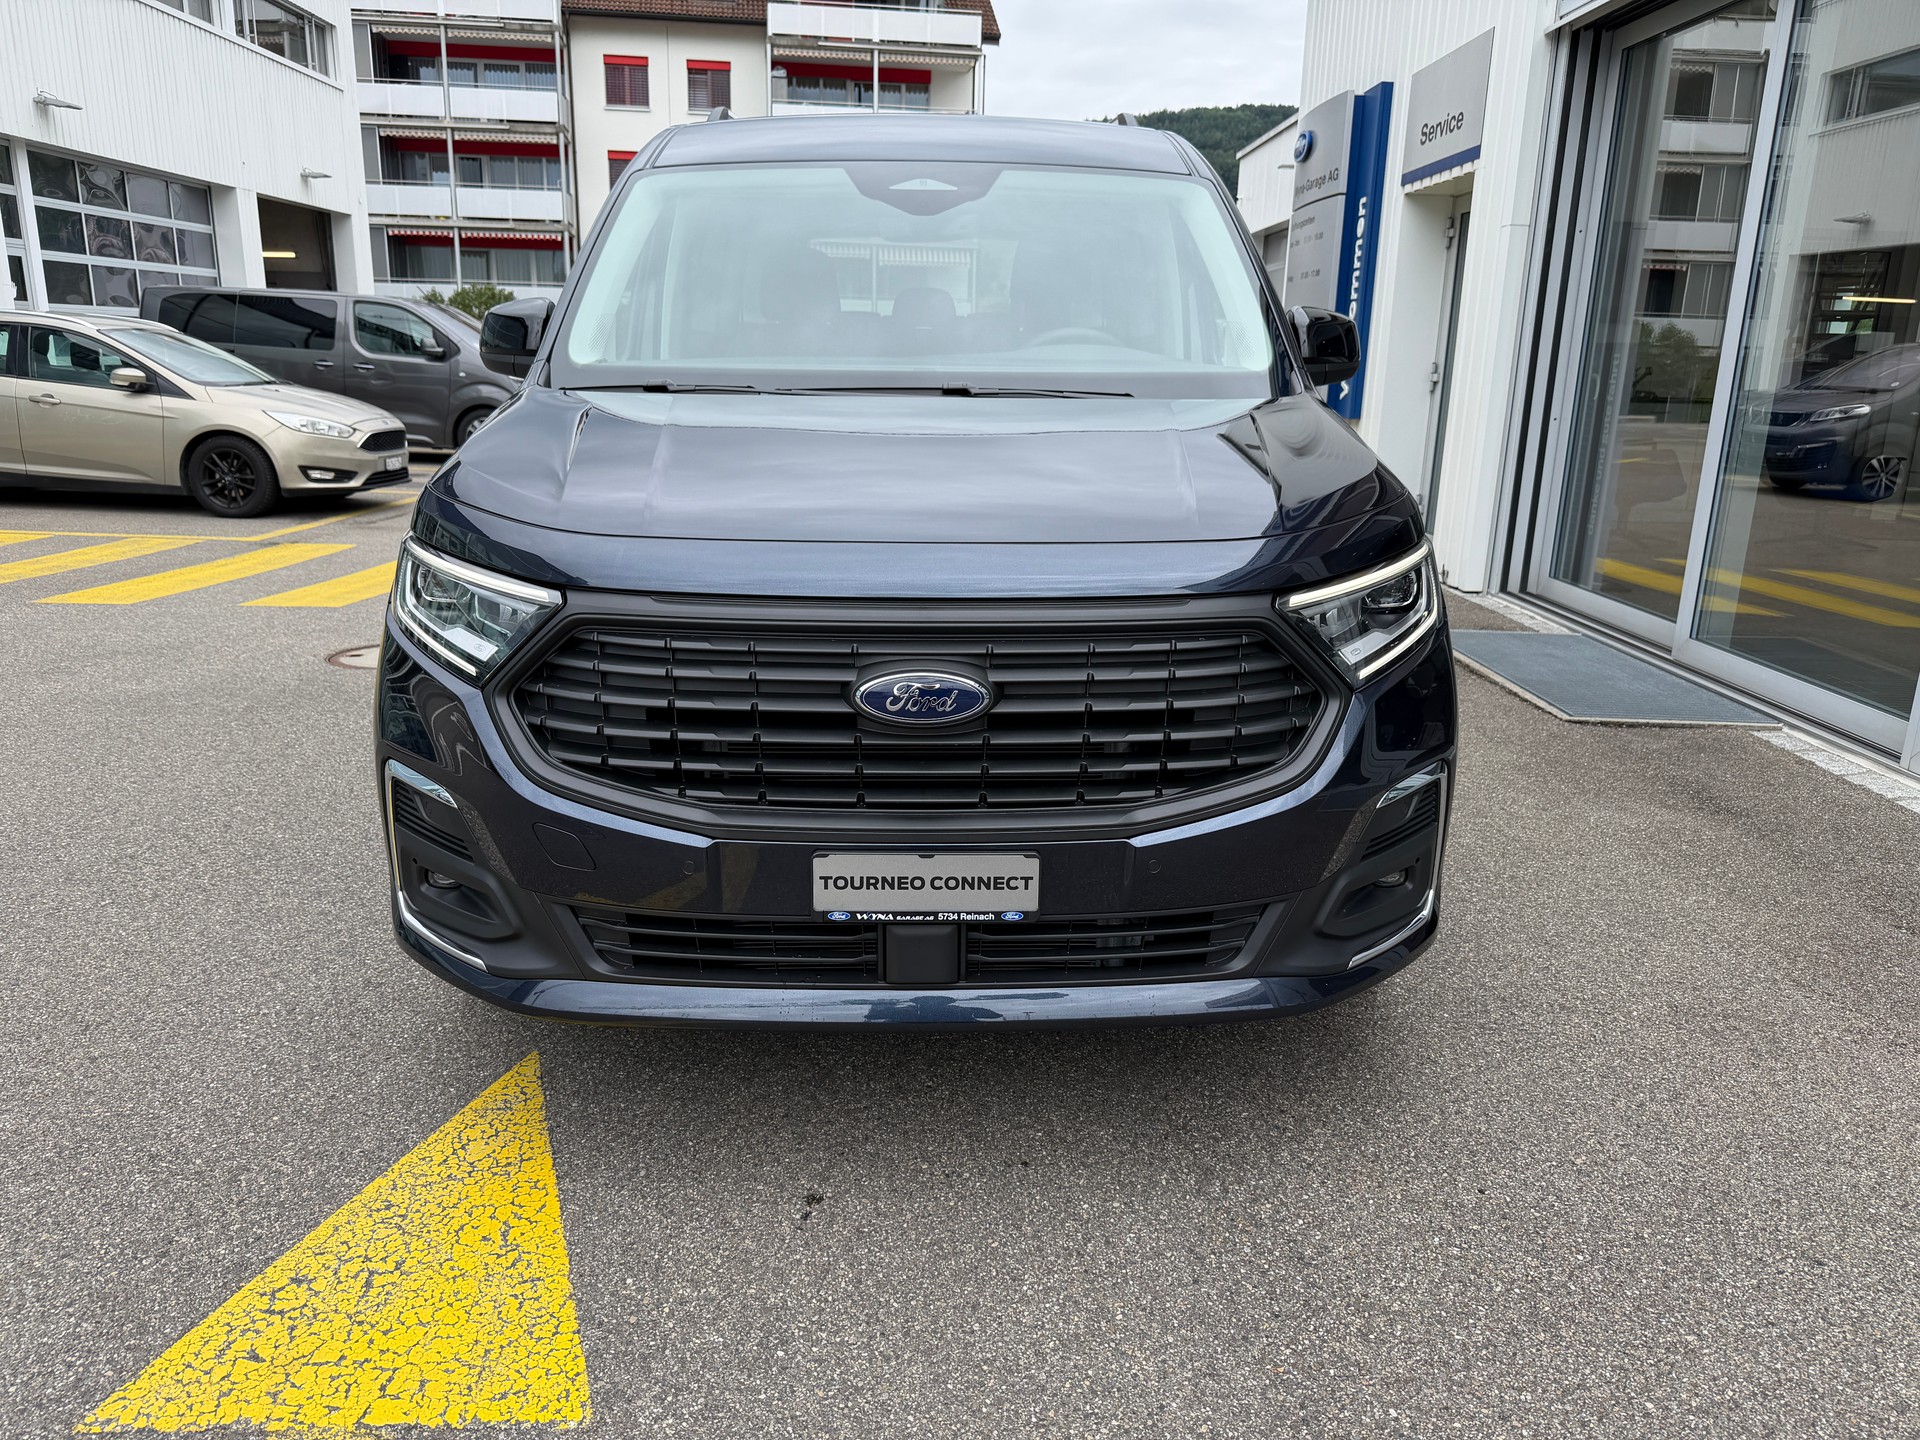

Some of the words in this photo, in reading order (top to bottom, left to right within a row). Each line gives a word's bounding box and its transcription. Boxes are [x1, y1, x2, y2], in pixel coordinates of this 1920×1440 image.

[1419, 111, 1465, 146] Service
[1327, 167, 1339, 183] AG
[1587, 484, 1601, 535] danke
[1596, 448, 1606, 480] und
[885, 681, 959, 712] Ford
[819, 875, 926, 891] TOURNEO
[930, 875, 1034, 891] CONNECT
[856, 912, 894, 921] WYNA
[938, 912, 958, 921] 5734
[960, 912, 995, 921] Reinach
